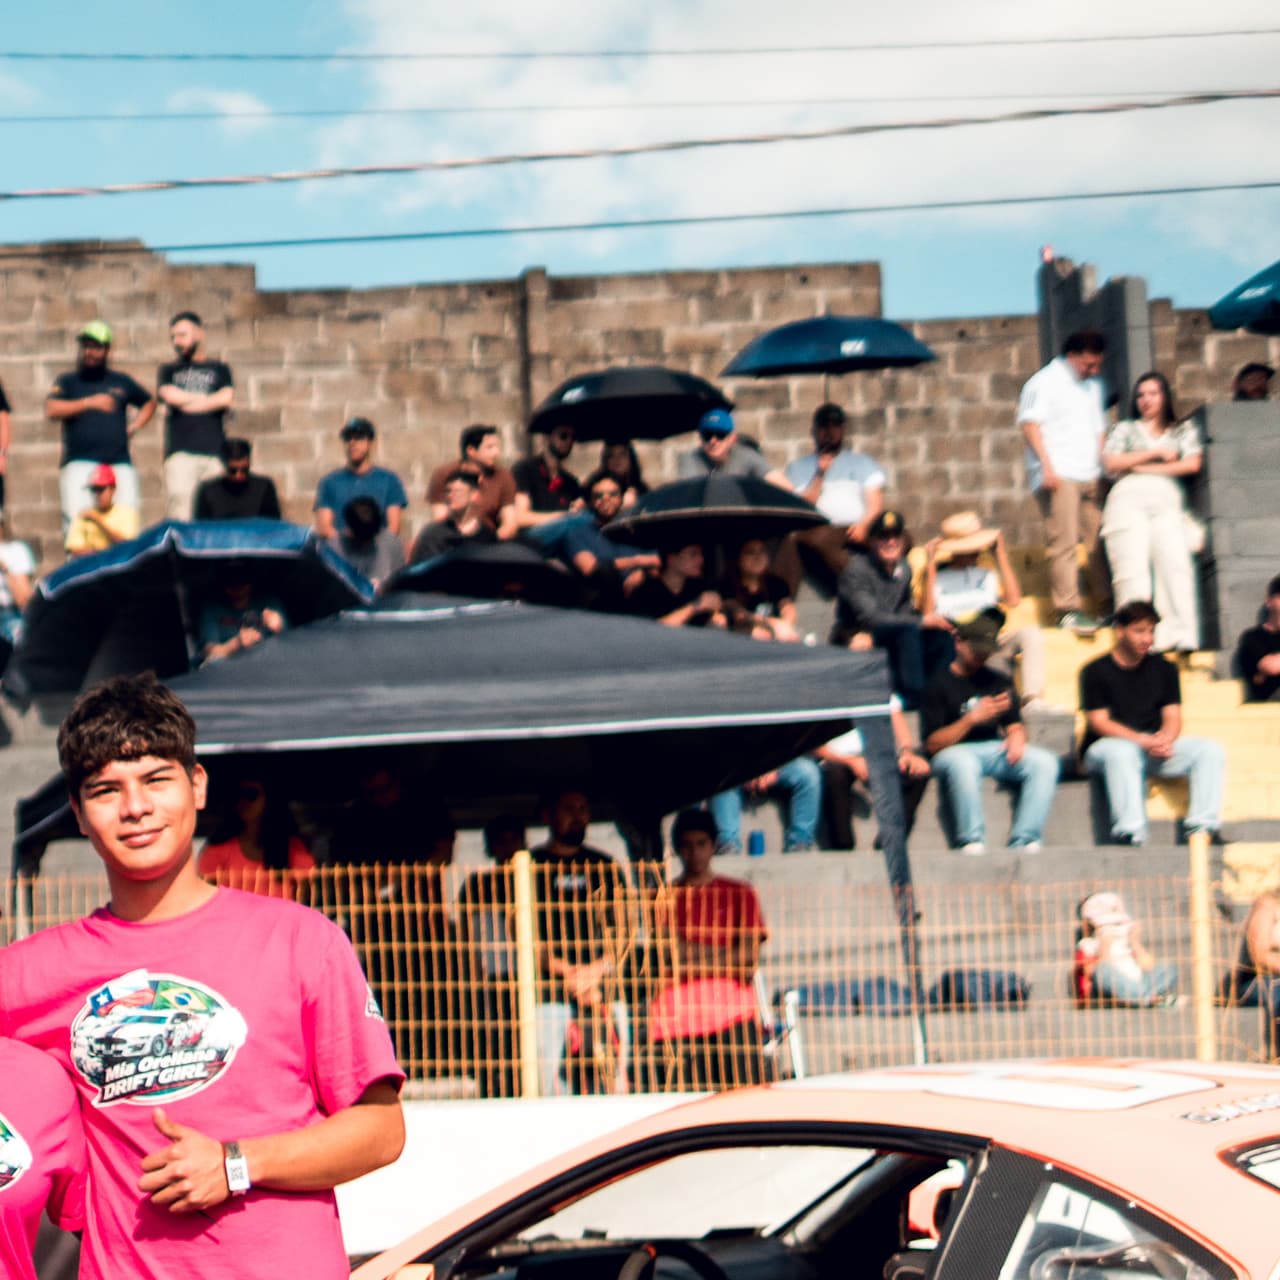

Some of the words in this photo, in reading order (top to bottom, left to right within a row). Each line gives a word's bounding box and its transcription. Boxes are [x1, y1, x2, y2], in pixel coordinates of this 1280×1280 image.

[103, 1070, 160, 1101] DRIFT
[157, 1062, 210, 1085] GIRL
[105, 1060, 137, 1084] Mia
[138, 1048, 217, 1072] Orellana
